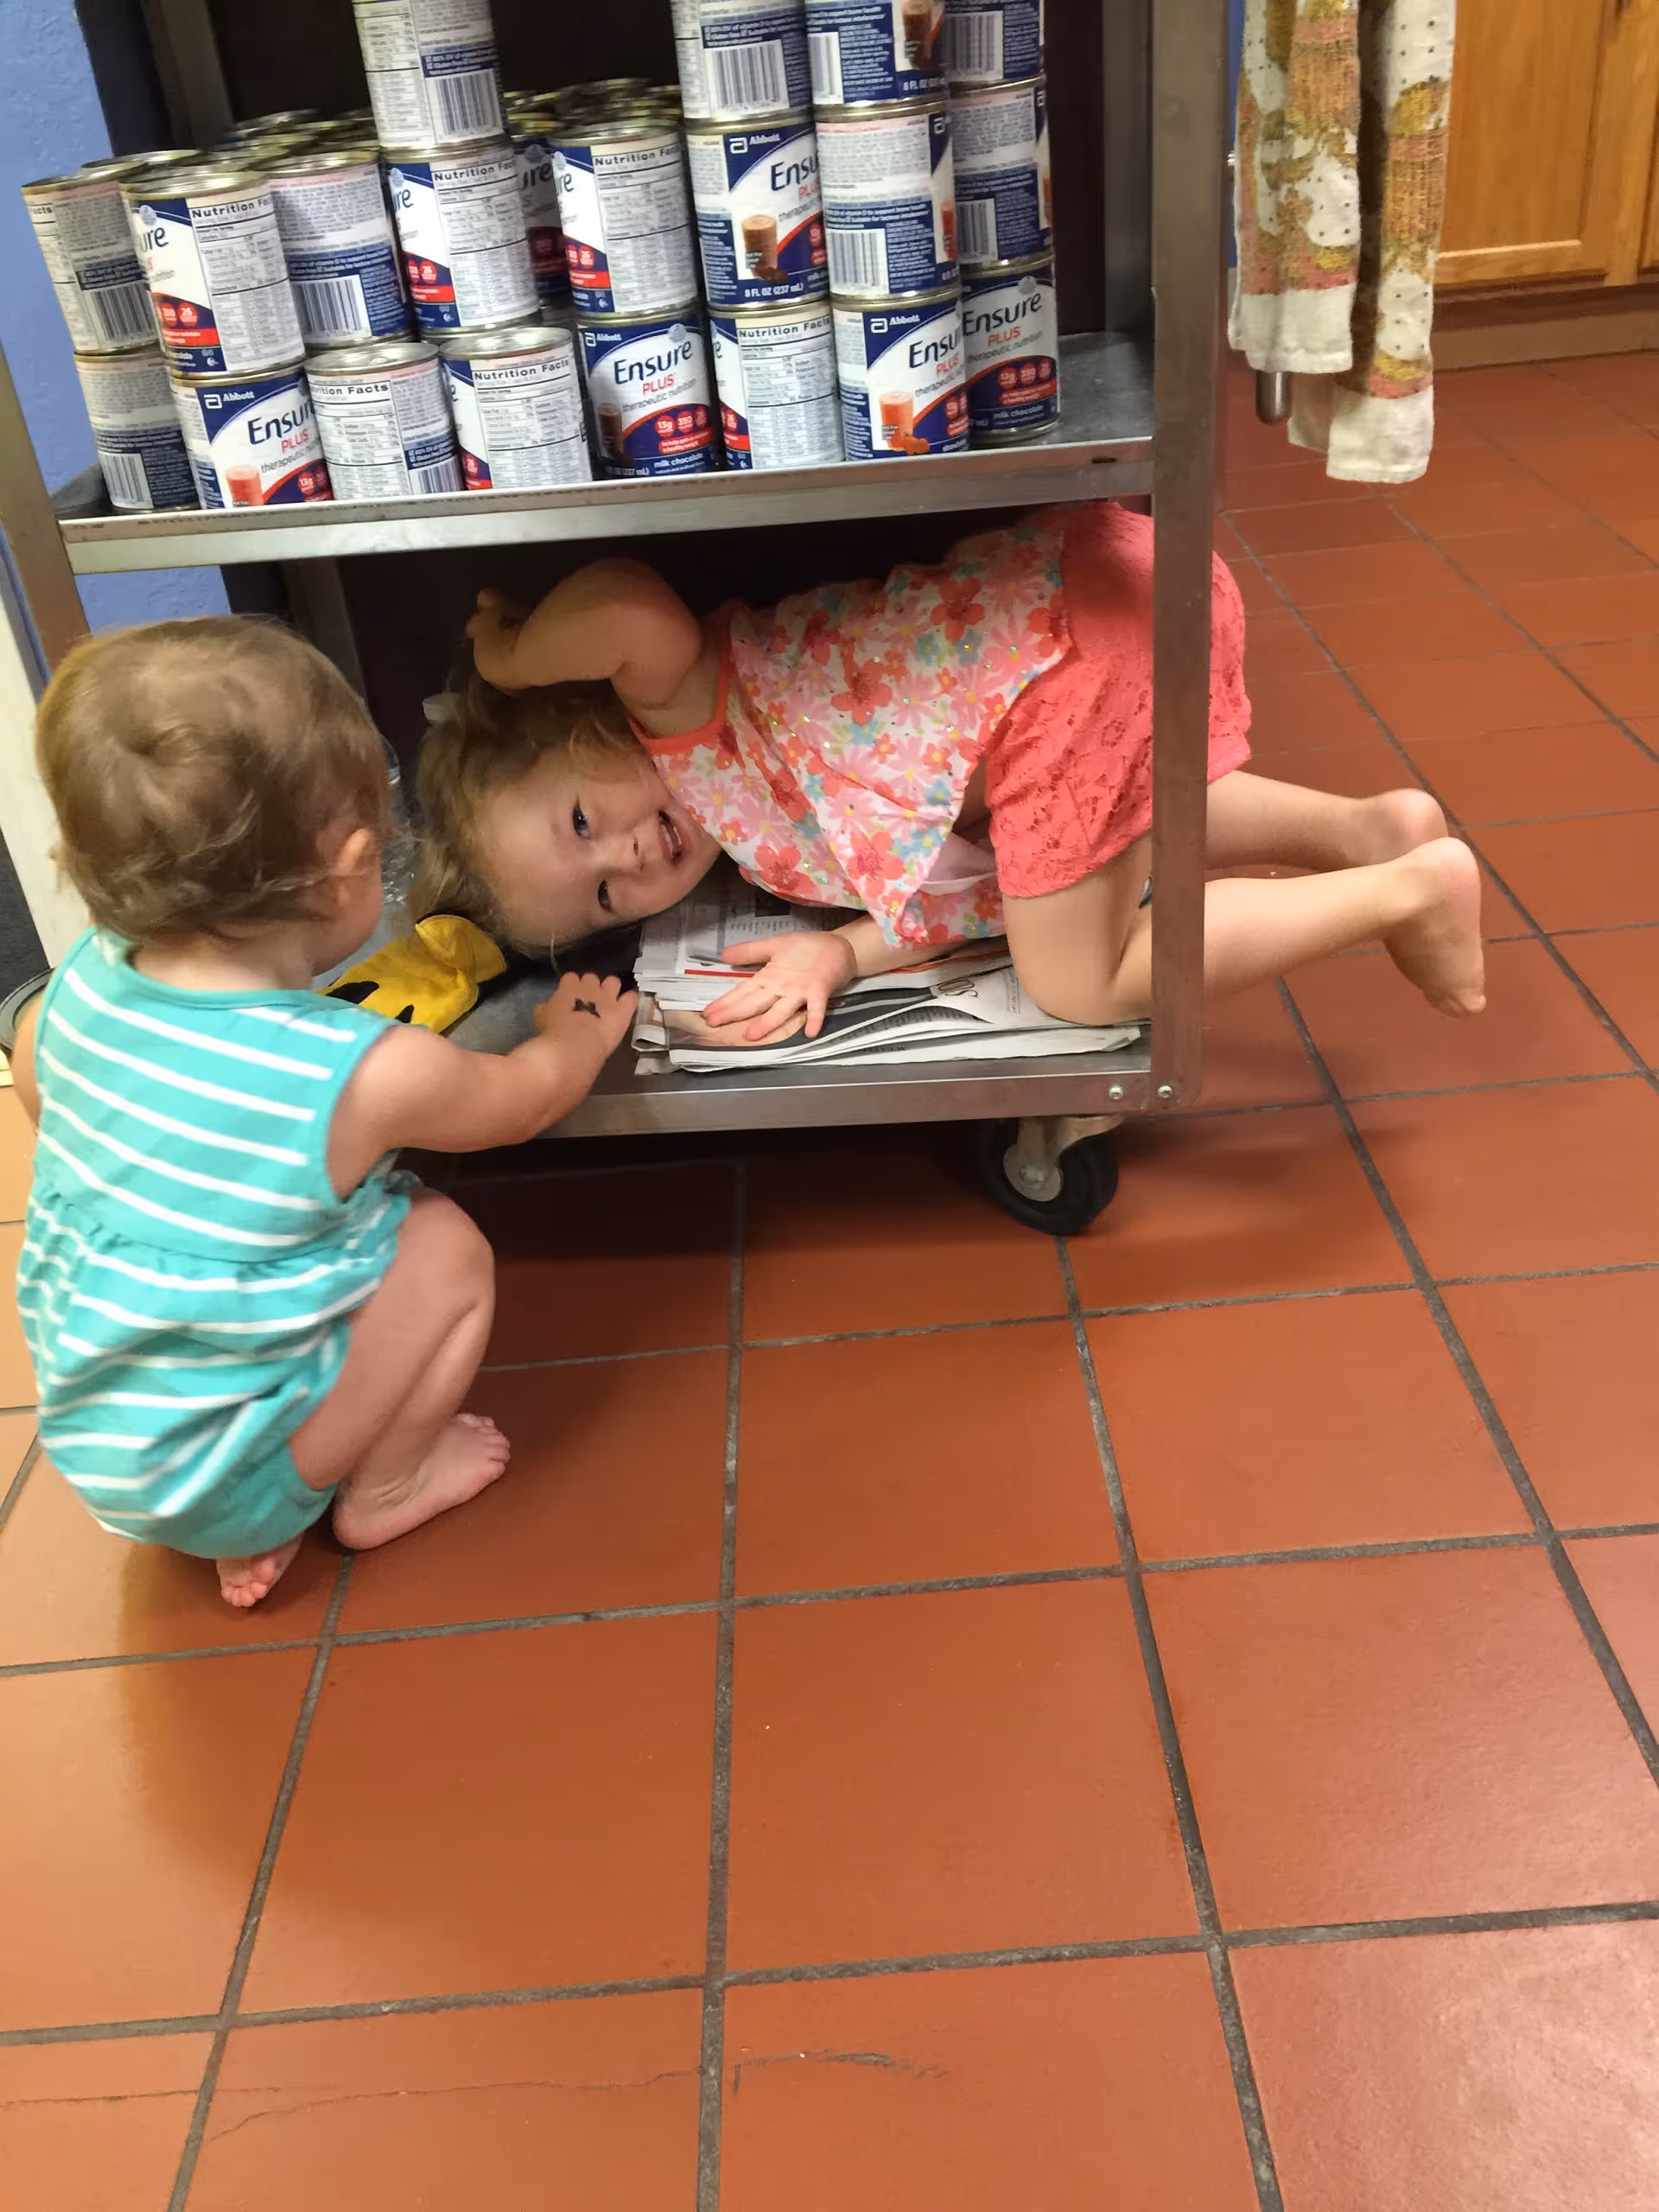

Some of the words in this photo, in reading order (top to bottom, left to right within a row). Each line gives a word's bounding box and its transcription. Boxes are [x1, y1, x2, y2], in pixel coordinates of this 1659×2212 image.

[594, 151, 656, 166] Nutrition
[434, 166, 495, 181] Nutrition
[192, 201, 255, 219] Nutrition
[889, 314, 920, 326] Abbott
[963, 293, 1043, 337] Ensure
[739, 326, 799, 339] Nutrition
[803, 316, 830, 332] Facts
[988, 325, 1022, 346] PLUS
[474, 366, 537, 381] Nutrition
[542, 357, 570, 372] Facts
[613, 340, 694, 385] Ensure
[347, 383, 389, 395] Facts
[642, 372, 676, 395] PLUS
[222, 391, 256, 403] Abbott
[622, 393, 668, 412] therapeutic
[281, 429, 309, 454] PLUS
[261, 448, 302, 474] therapeutic
[654, 460, 671, 468] milk
[671, 453, 703, 466] chocolate
